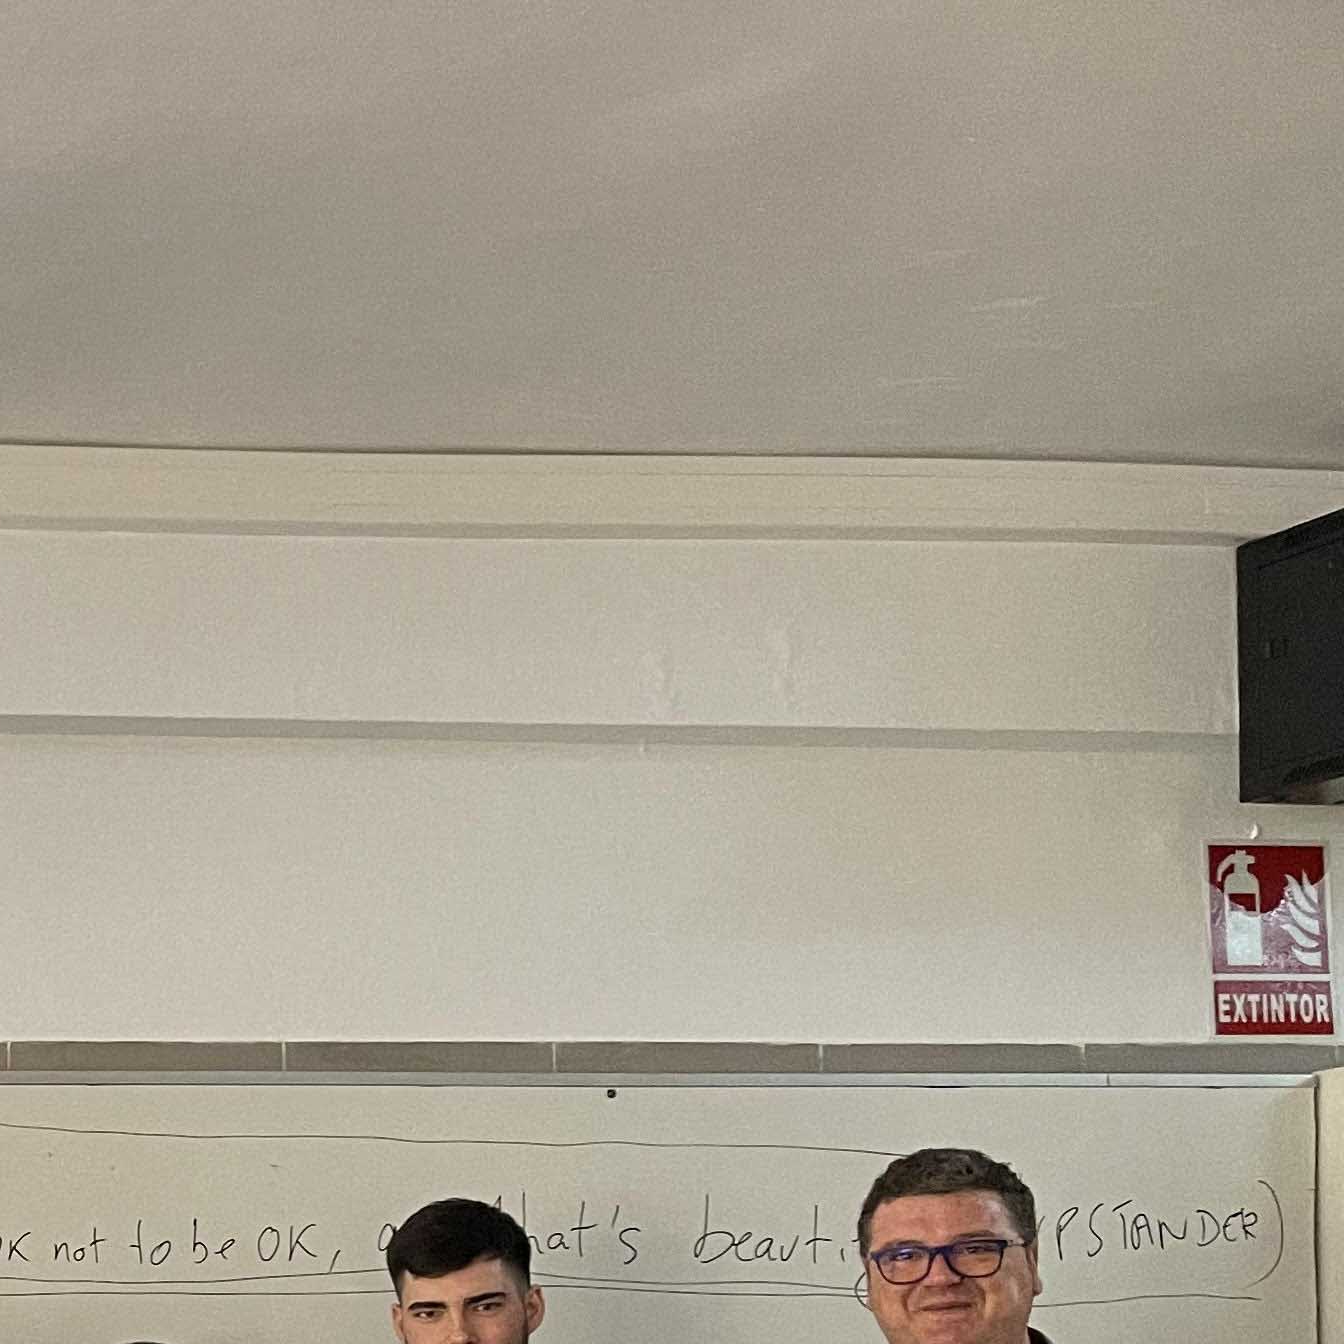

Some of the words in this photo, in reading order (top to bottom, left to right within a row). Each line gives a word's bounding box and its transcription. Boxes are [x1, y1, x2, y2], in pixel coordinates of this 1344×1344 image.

[1218, 993, 1330, 1023] EXTINTOR
[52, 1228, 108, 1266] not
[129, 1220, 168, 1267] to
[190, 1218, 238, 1265] be
